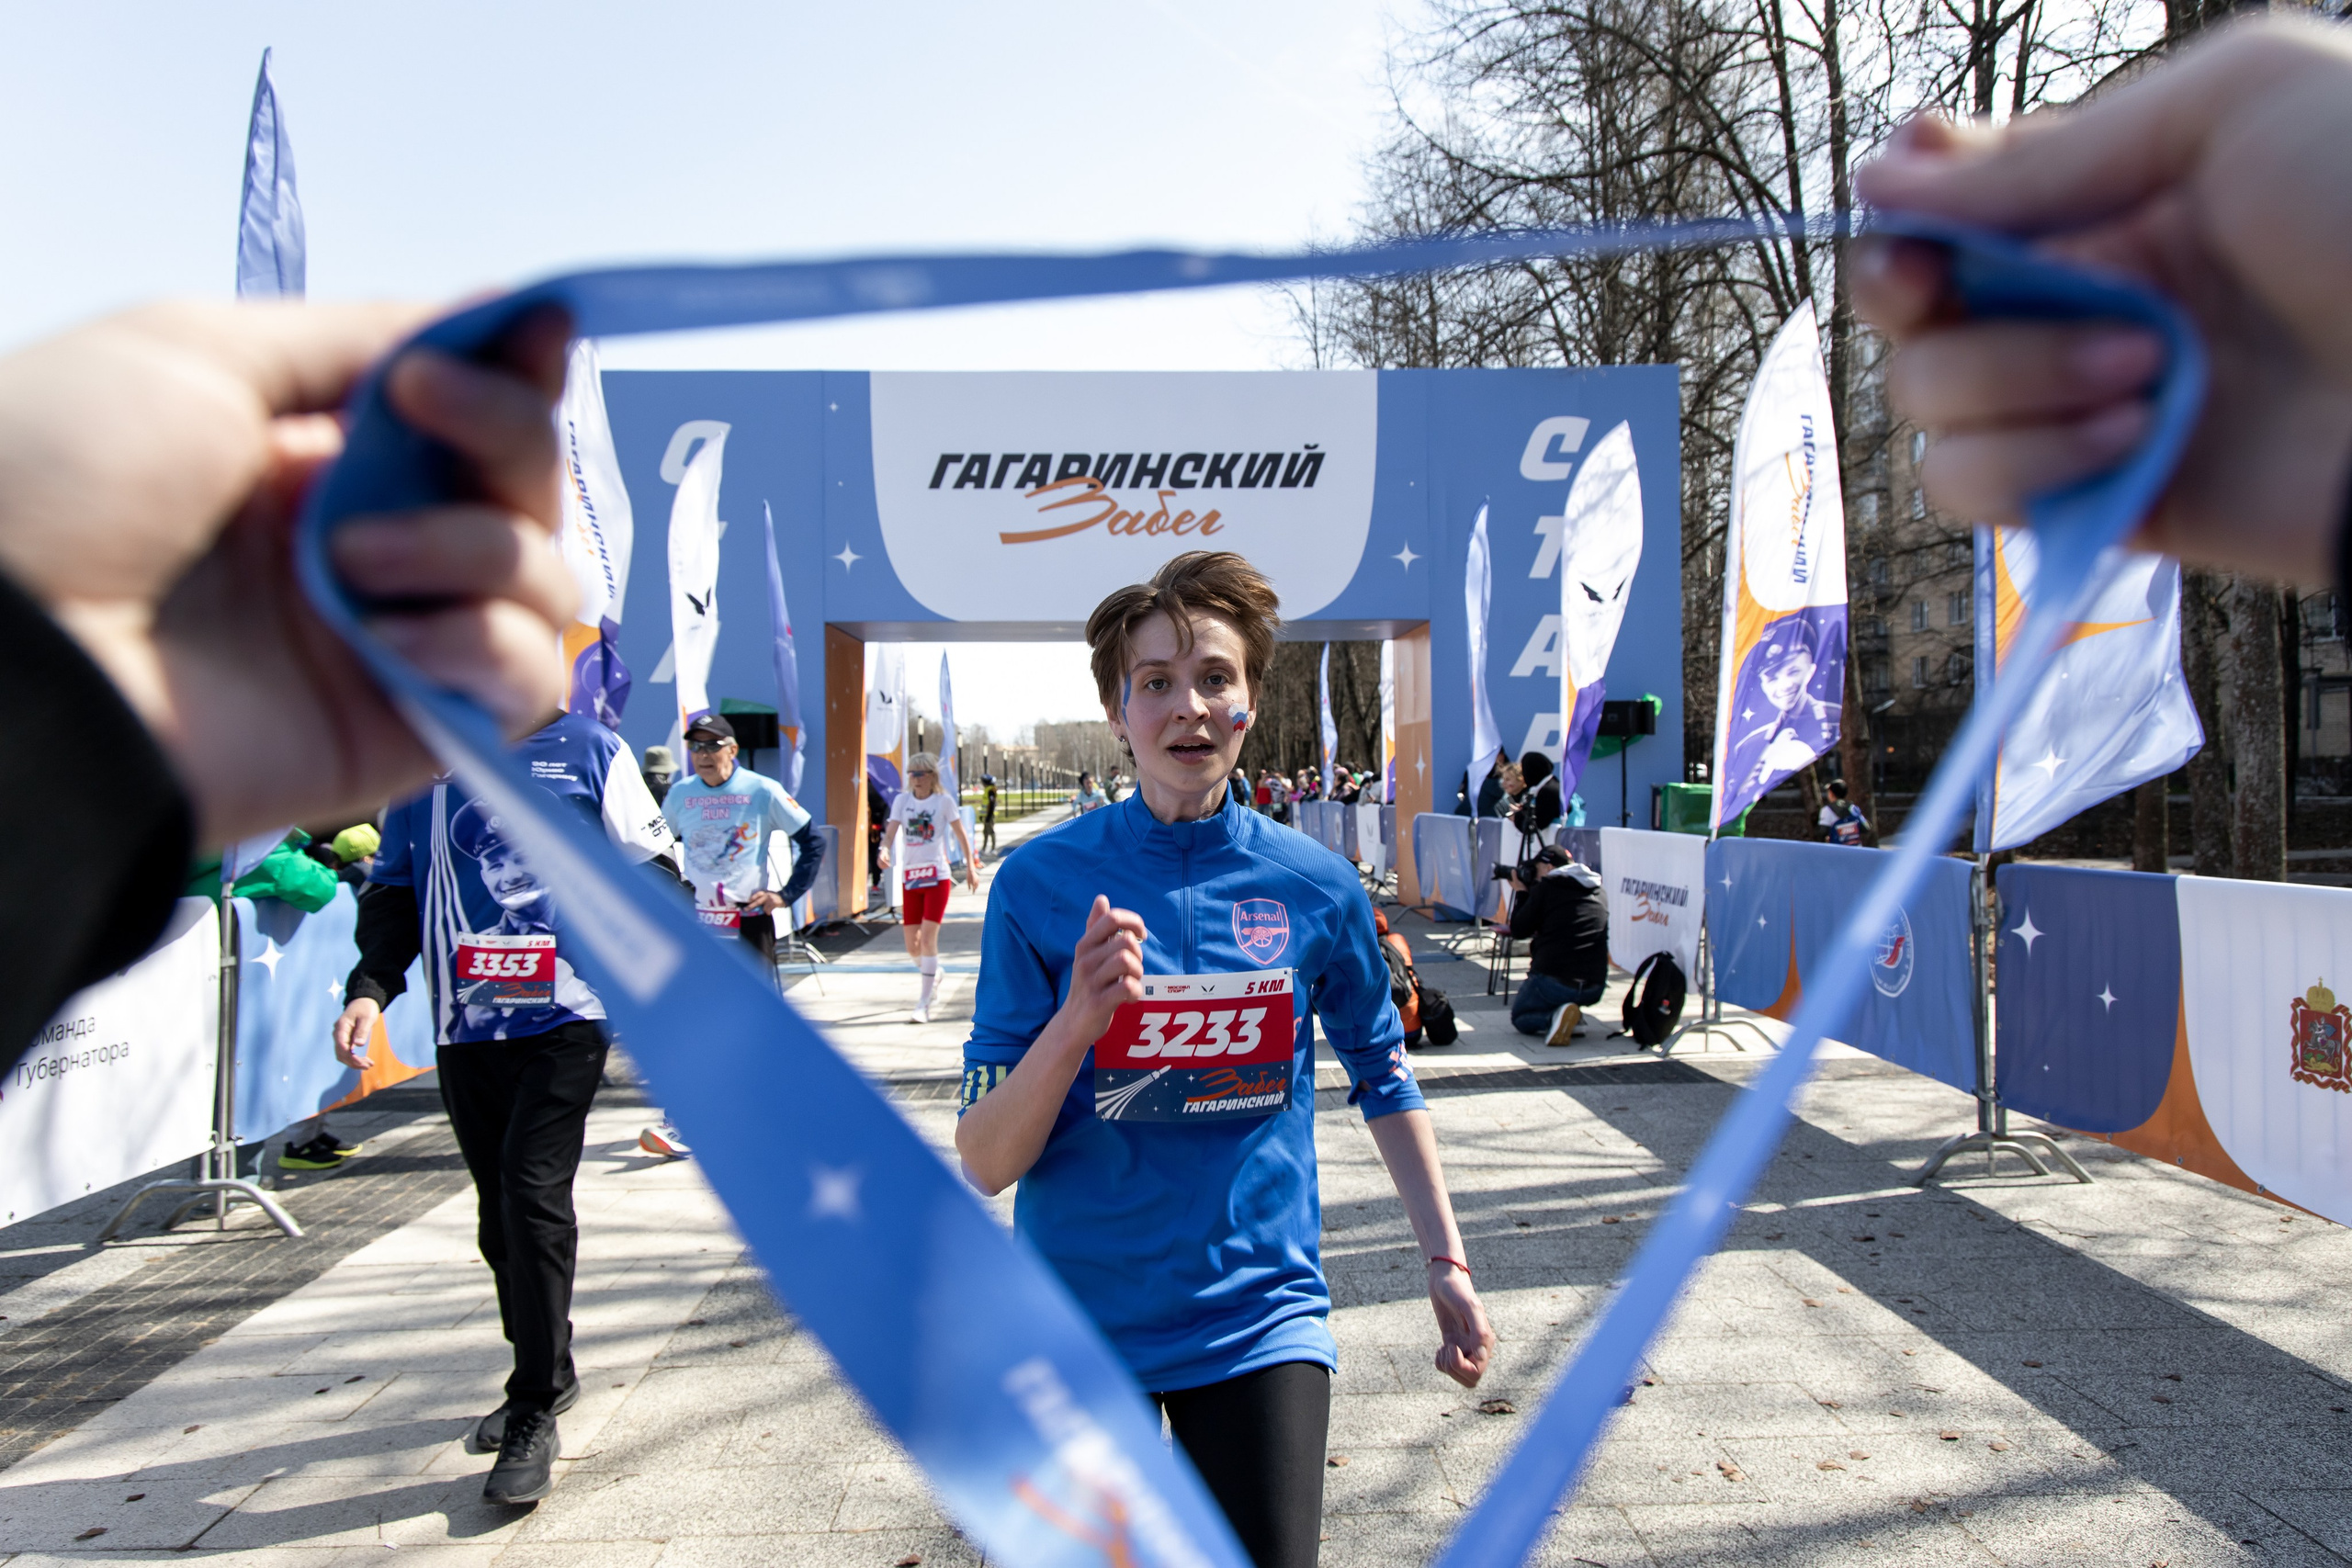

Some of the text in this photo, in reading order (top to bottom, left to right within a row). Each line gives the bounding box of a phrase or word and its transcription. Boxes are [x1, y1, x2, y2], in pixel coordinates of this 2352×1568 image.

[929, 444, 1326, 489] ГАГАРИНСКИЙ
[999, 476, 1225, 544] Забег
[701, 808, 729, 819] RUN
[1621, 877, 1689, 908] ГАГАРИНСКИЙ
[1240, 910, 1281, 921] Arsenal
[468, 952, 542, 977] 3353
[1244, 981, 1254, 995] 5
[30, 1016, 96, 1047] оманда
[1126, 1007, 1268, 1059] 3233
[17, 1042, 130, 1089] Губернатора
[1186, 1068, 1287, 1102] Забег
[1182, 1090, 1285, 1113] ГАГАРИНСКИЙ
